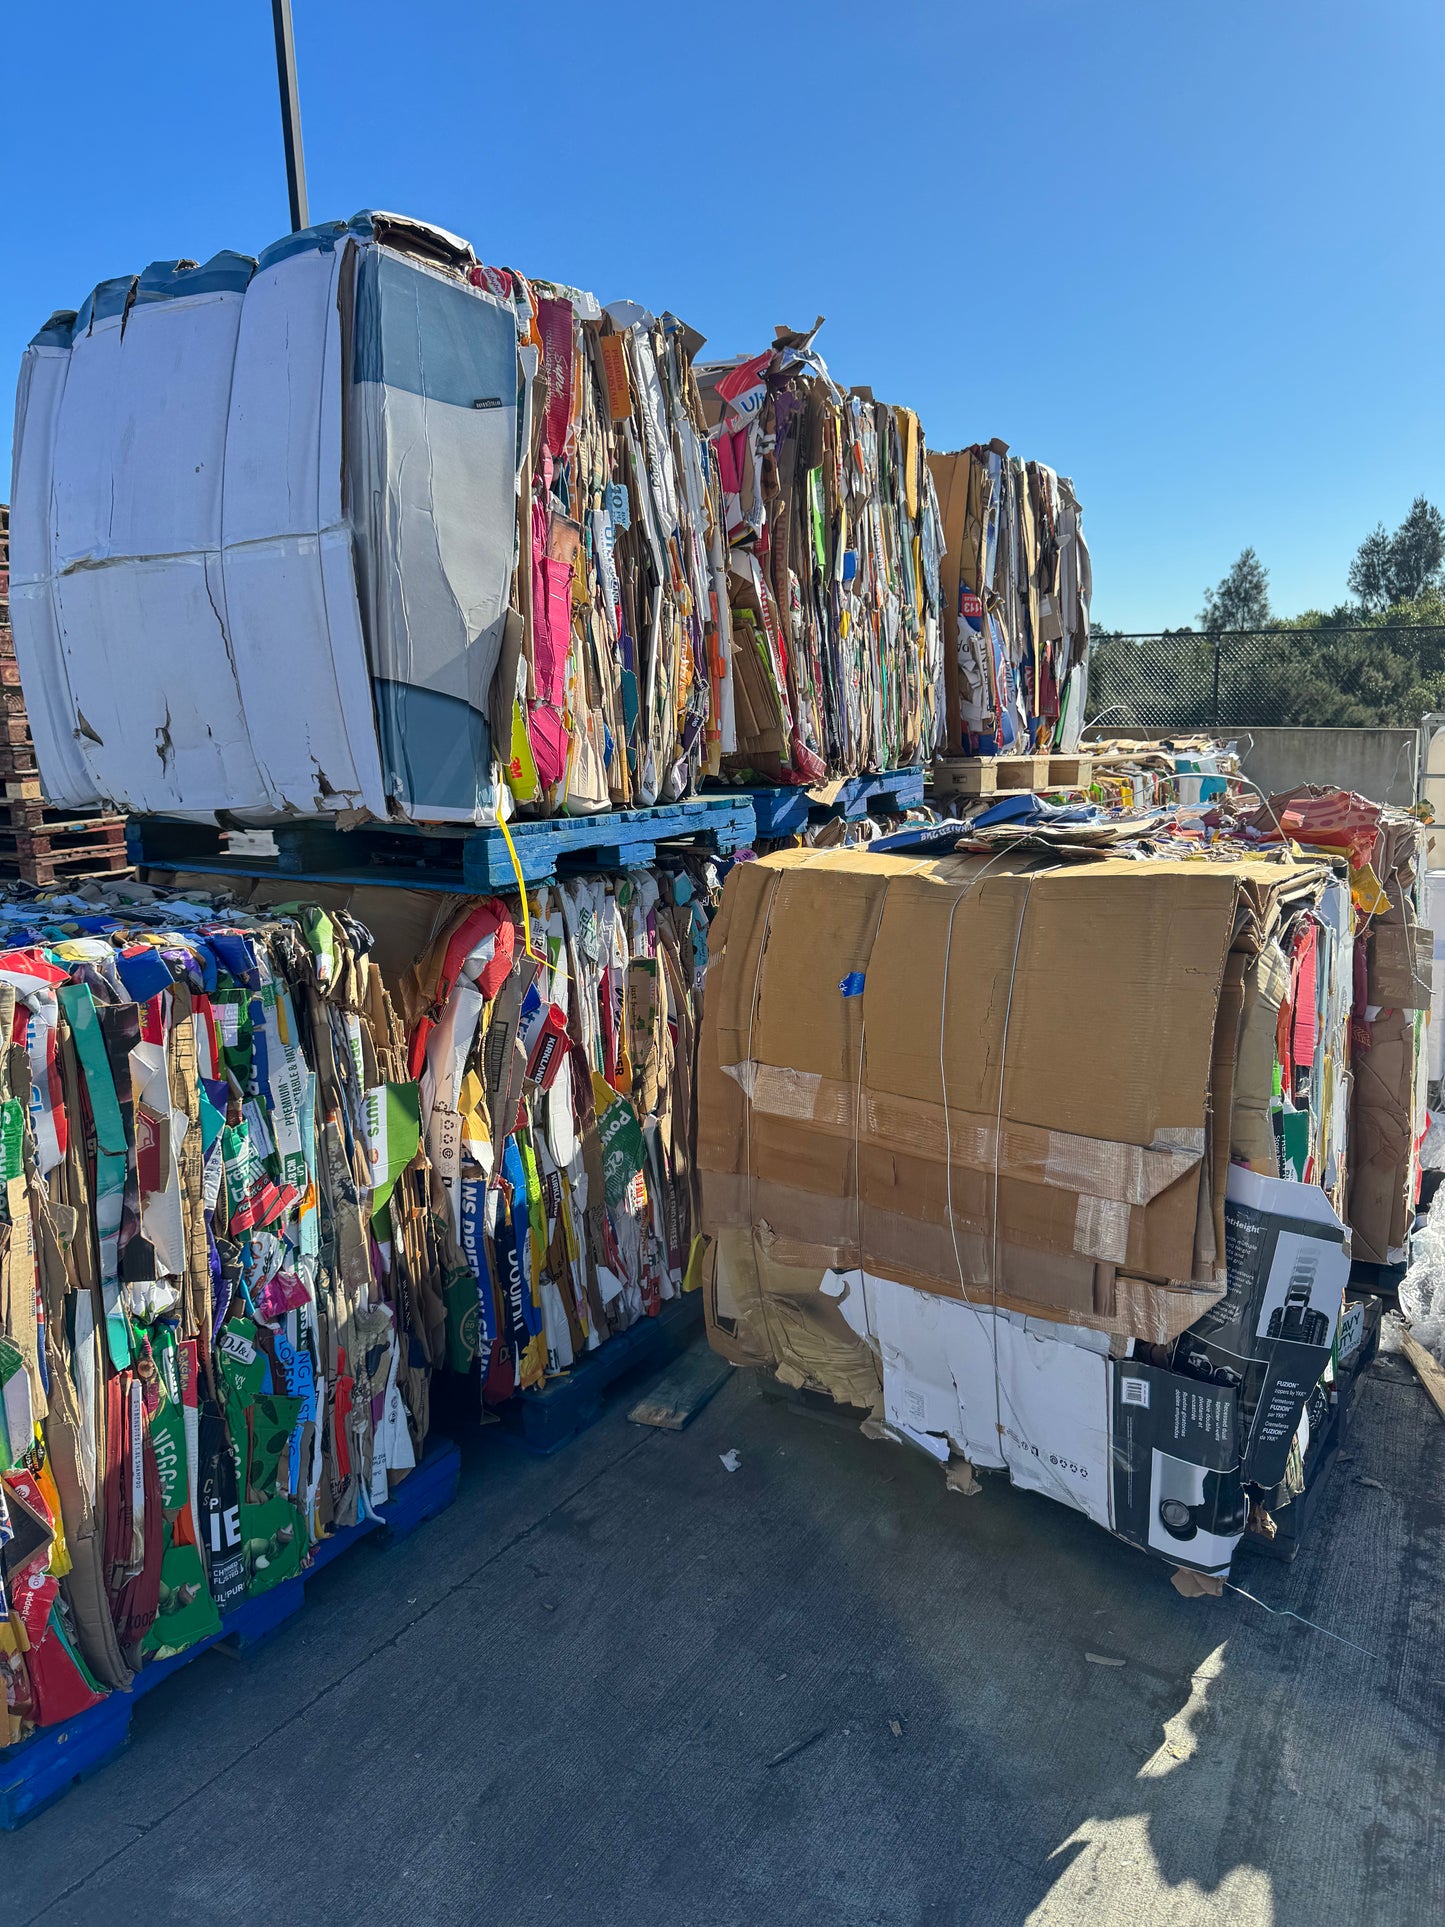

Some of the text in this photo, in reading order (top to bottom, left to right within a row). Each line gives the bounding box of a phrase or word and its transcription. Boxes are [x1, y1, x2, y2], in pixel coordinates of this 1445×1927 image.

[611, 350, 624, 391] PREMIUM
[963, 604, 981, 615] 113
[510, 756, 523, 779] 3M
[534, 1037, 556, 1084] KIRKLAND
[278, 1083, 294, 1126] PREMIUM
[367, 1095, 379, 1138] NUTS
[1342, 1311, 1360, 1333] AVY
[1222, 1402, 1230, 1427] Recessed
[24, 1591, 33, 1616] added
